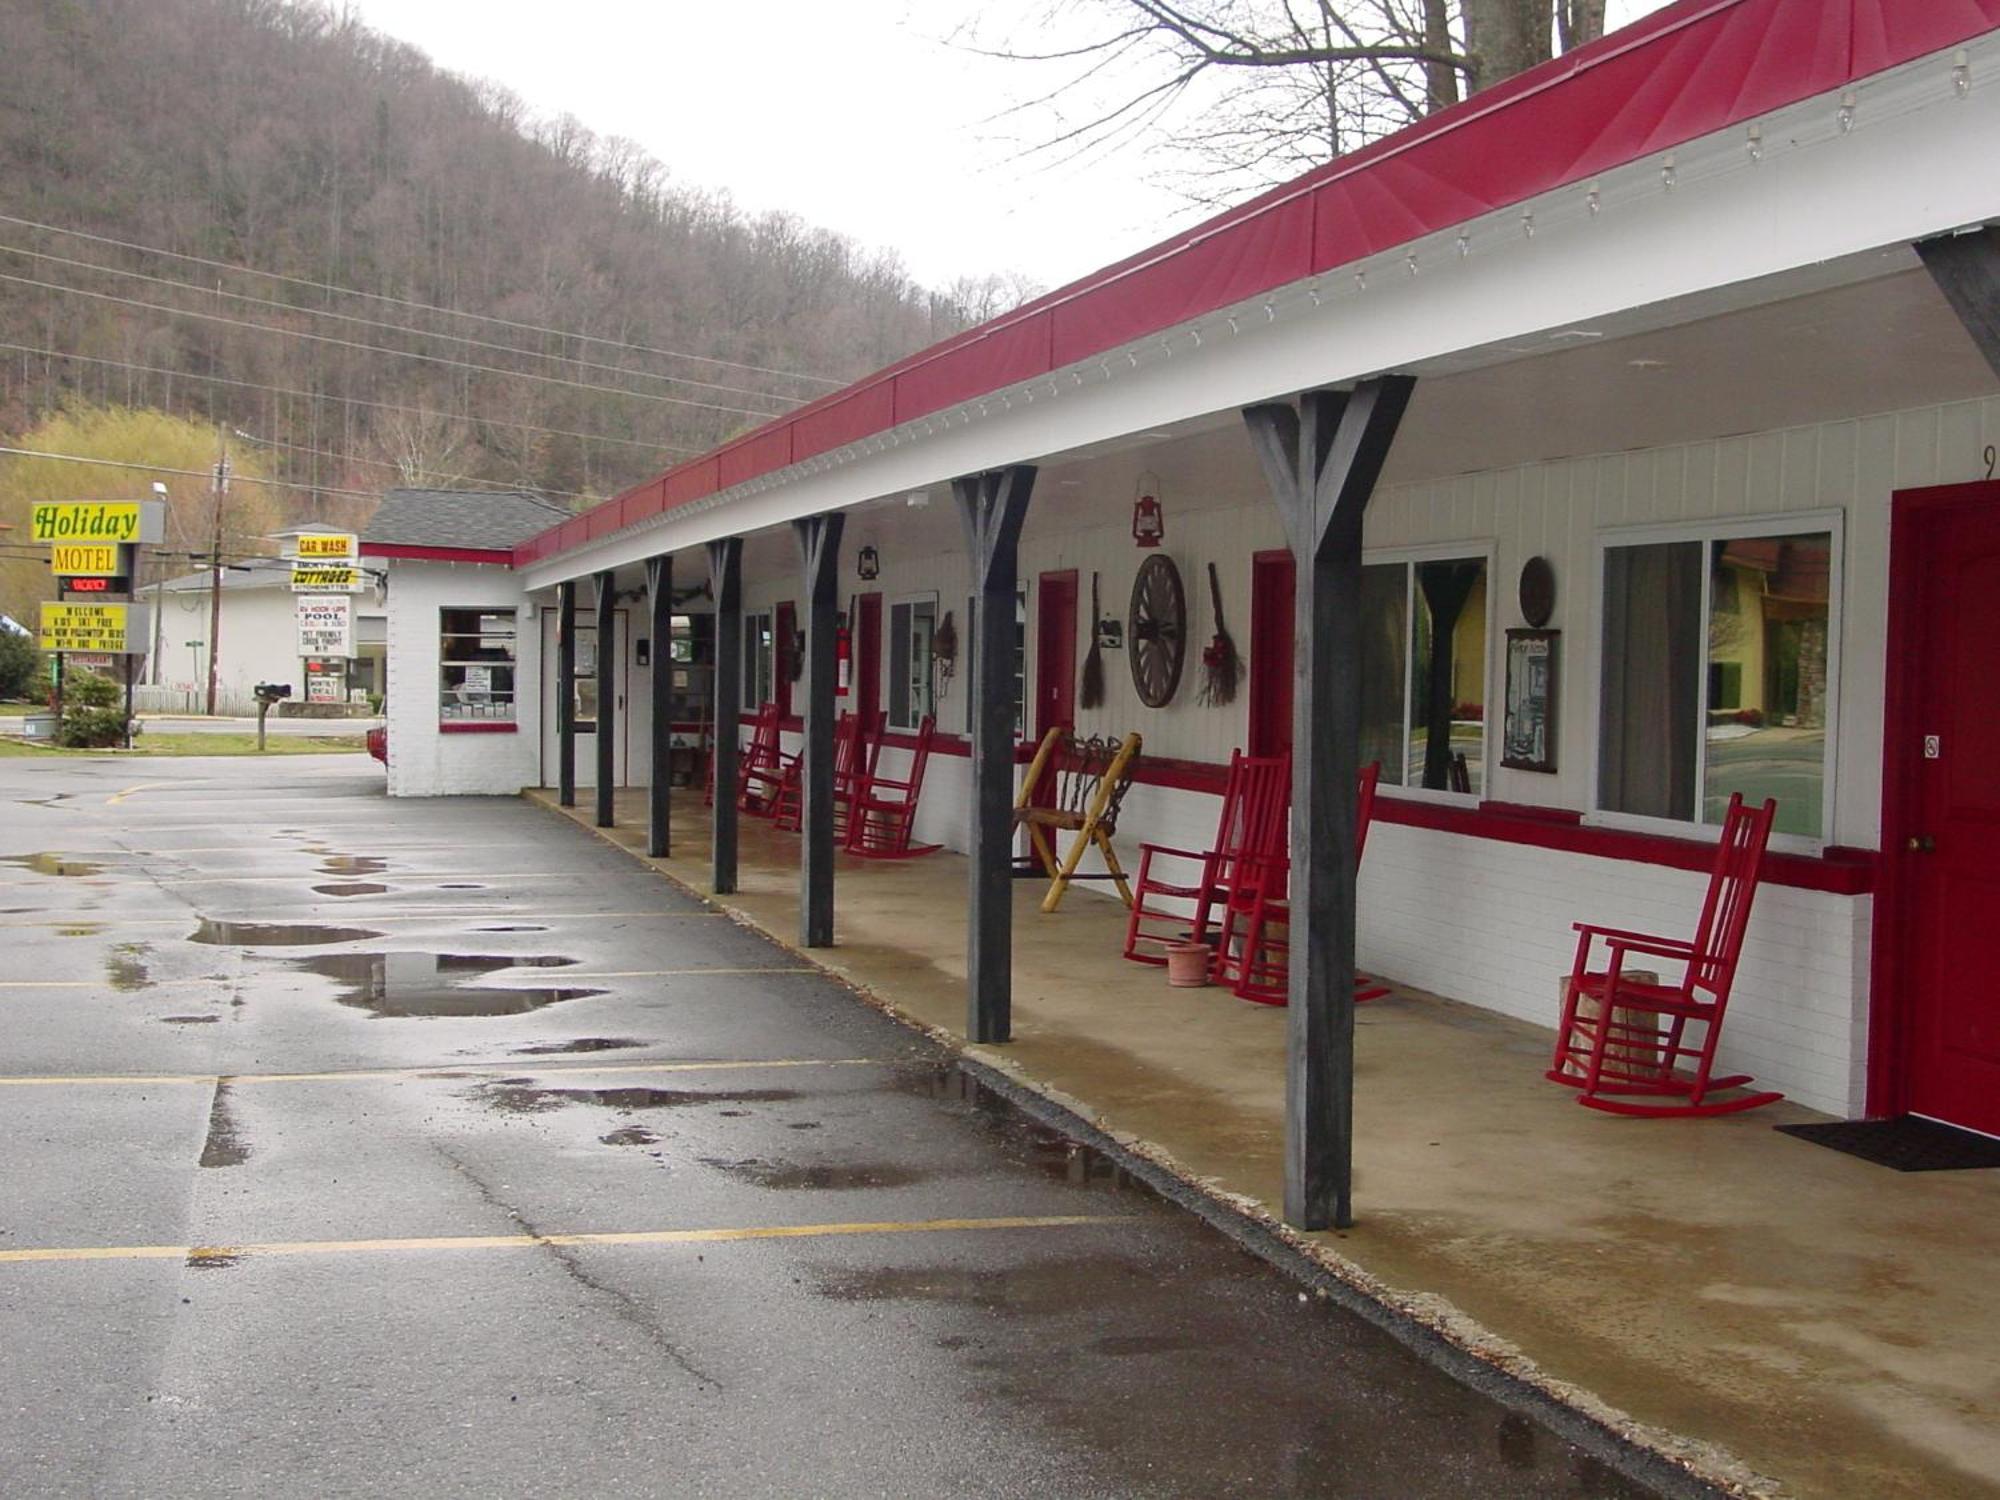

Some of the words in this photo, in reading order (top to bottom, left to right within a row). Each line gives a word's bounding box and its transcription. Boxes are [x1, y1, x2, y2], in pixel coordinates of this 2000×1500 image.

[1984, 445, 1996, 480] 9
[36, 506, 137, 540] Holiday
[299, 539, 317, 553] CAR
[321, 539, 347, 553] WASH
[55, 548, 114, 571] MOTEL
[293, 570, 352, 584] COTTAGES
[66, 607, 104, 616] WELCOME
[97, 618, 112, 627] FREE
[55, 628, 67, 637] NEW
